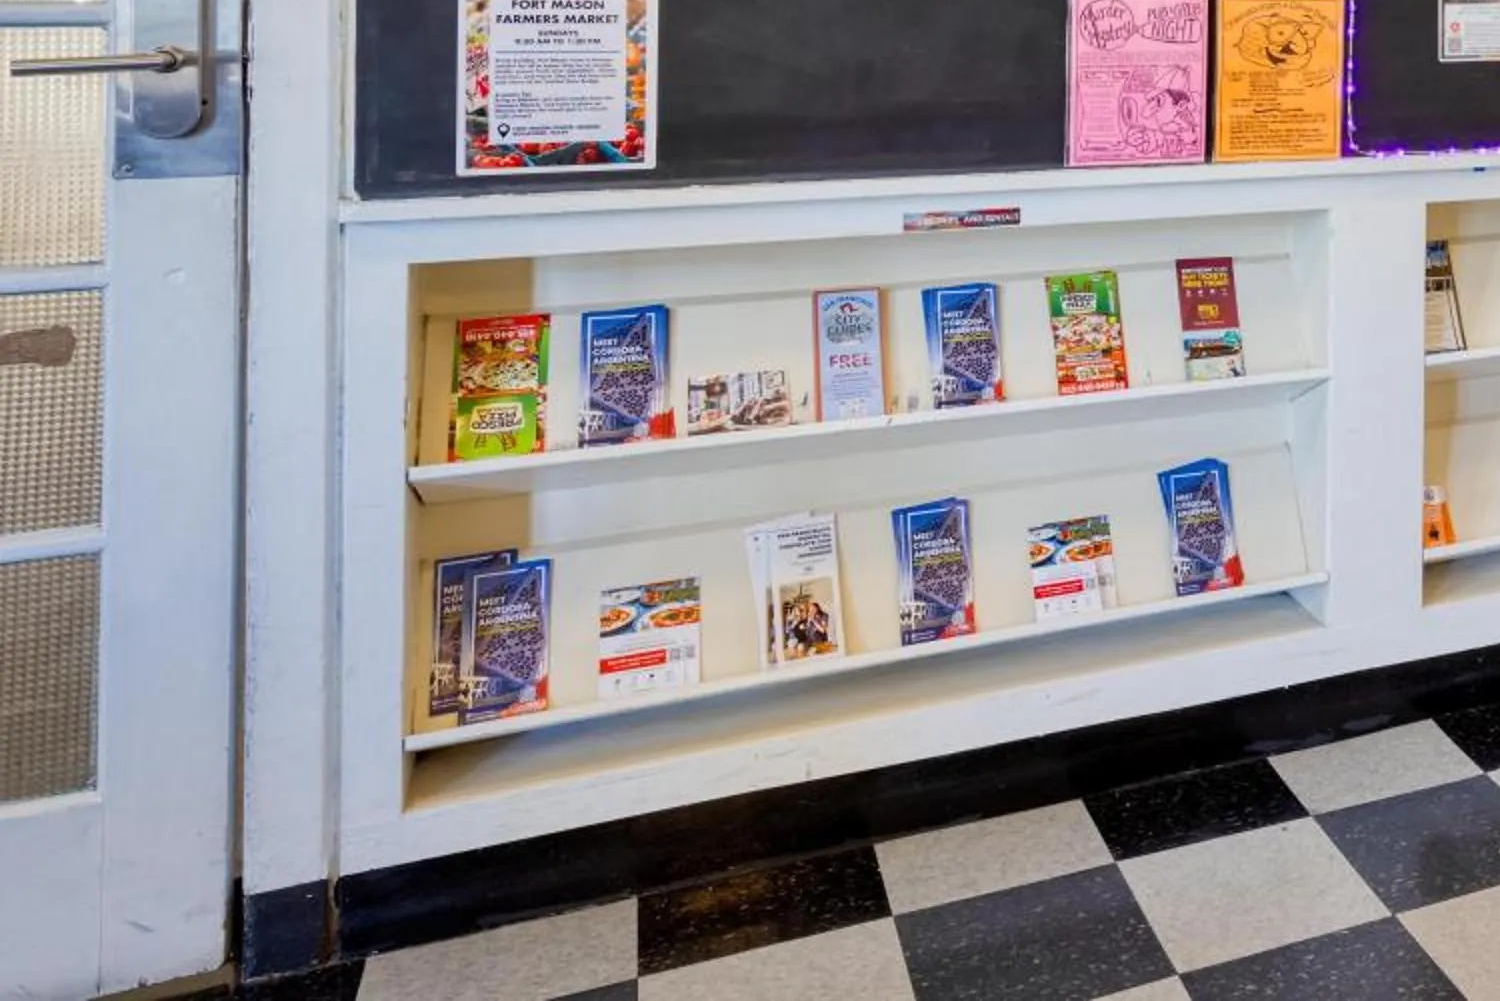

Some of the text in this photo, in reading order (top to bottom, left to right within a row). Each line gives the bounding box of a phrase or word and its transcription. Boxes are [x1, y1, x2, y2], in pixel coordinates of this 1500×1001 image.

[511, 0, 605, 9] FORT MASON
[495, 14, 619, 24] FARMERS MARKET
[829, 353, 872, 368] FREE
